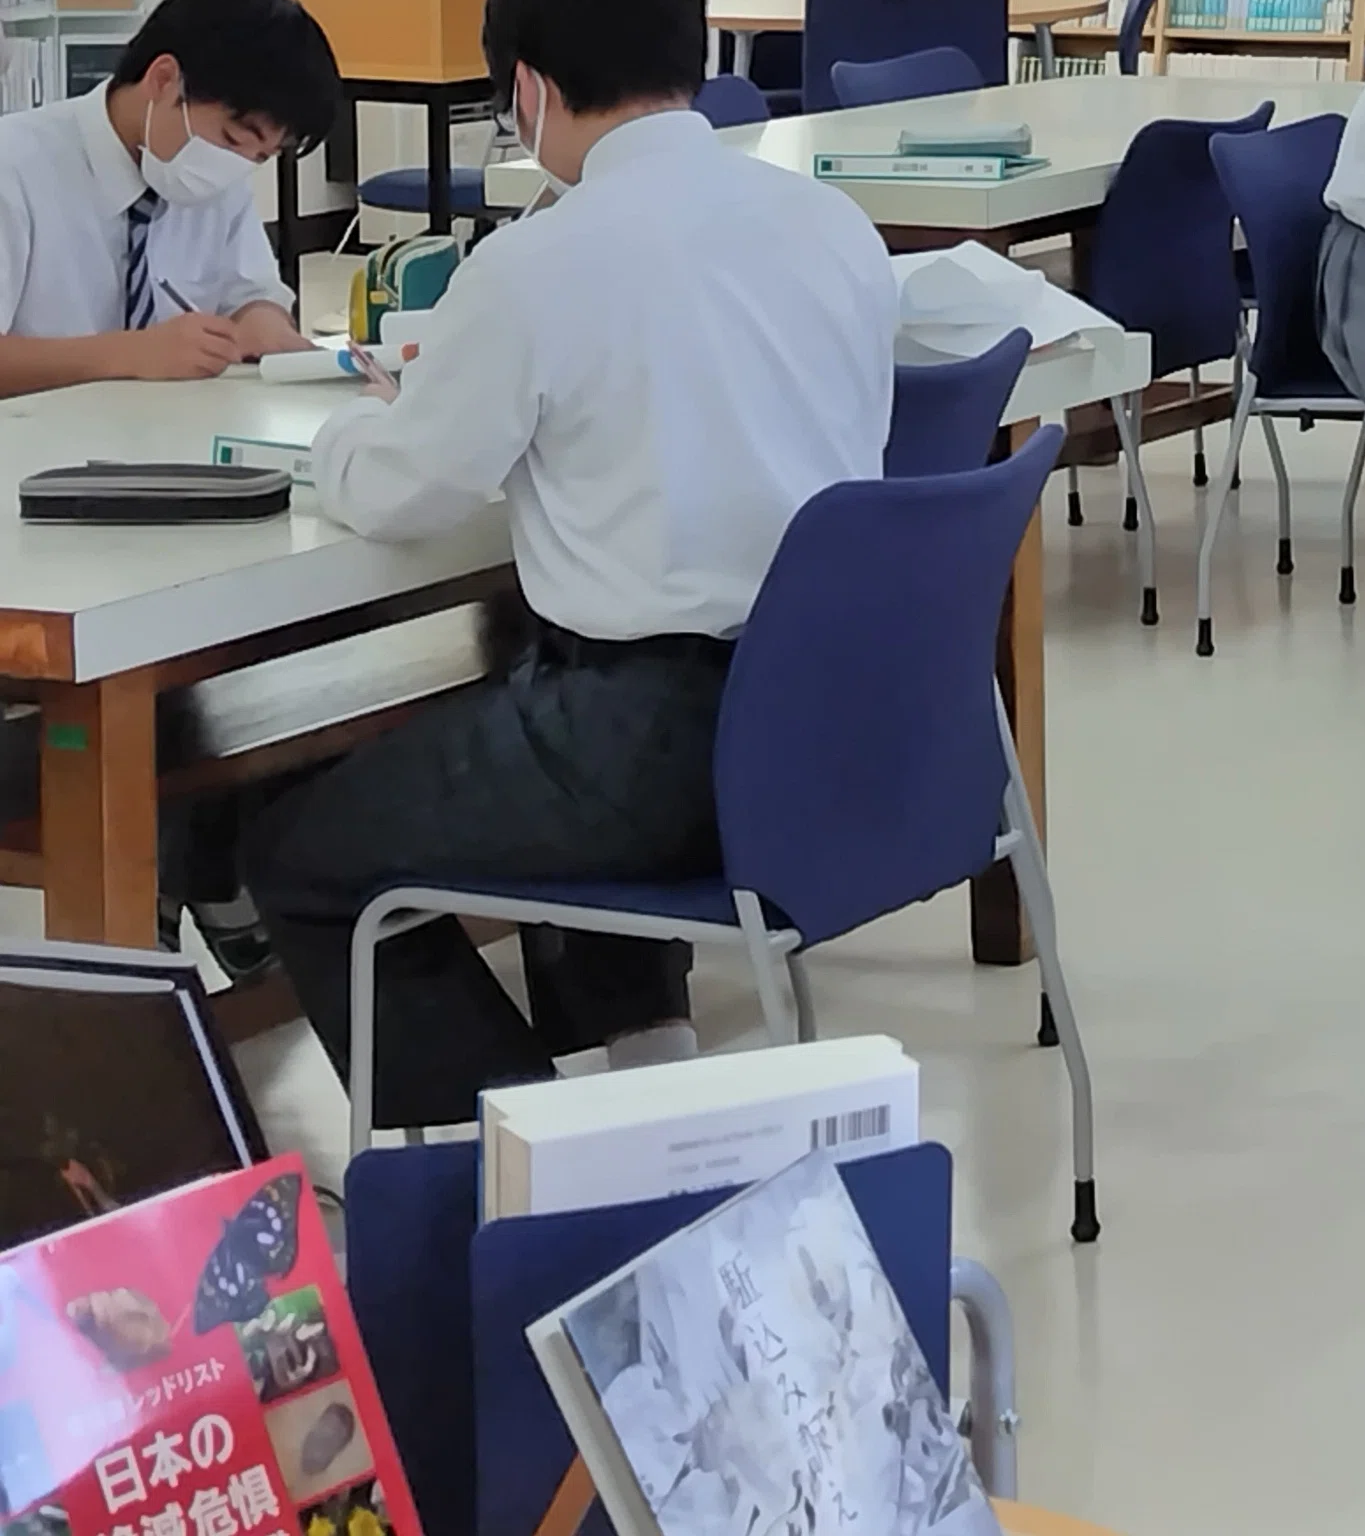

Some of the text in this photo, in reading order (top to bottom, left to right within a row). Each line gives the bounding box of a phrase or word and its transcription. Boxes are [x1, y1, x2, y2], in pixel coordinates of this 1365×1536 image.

[93, 1412, 235, 1515] 日本の
[96, 1463, 281, 1536] 滅危惧
